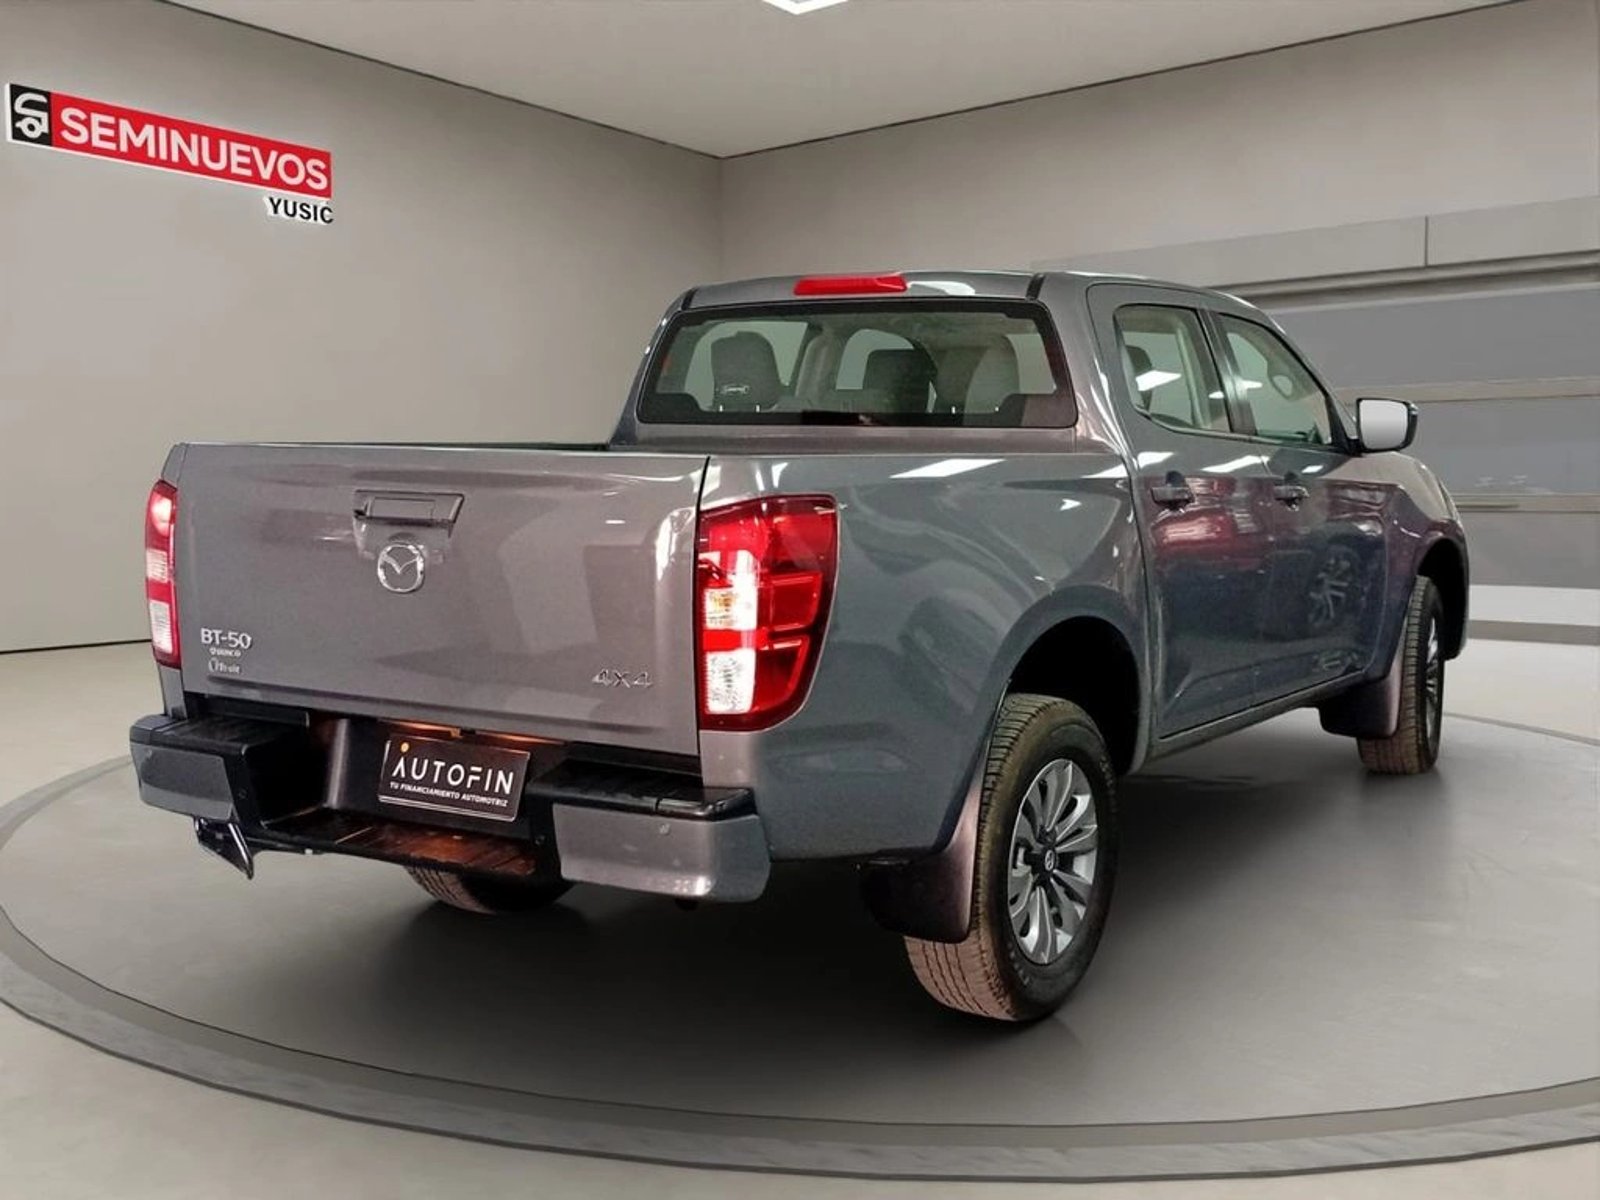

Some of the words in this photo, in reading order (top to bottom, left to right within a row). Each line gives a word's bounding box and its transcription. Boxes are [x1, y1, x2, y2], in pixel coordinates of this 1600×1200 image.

[60, 107, 328, 190] SEMINUEVOS
[269, 196, 334, 224] YUSIC
[201, 627, 252, 649] BT-50
[391, 754, 514, 795] AUTOFIN
[389, 781, 399, 790] TU
[400, 783, 460, 799] FINANCIAMIENTO
[461, 793, 509, 807] AUTOMOTRIZ
